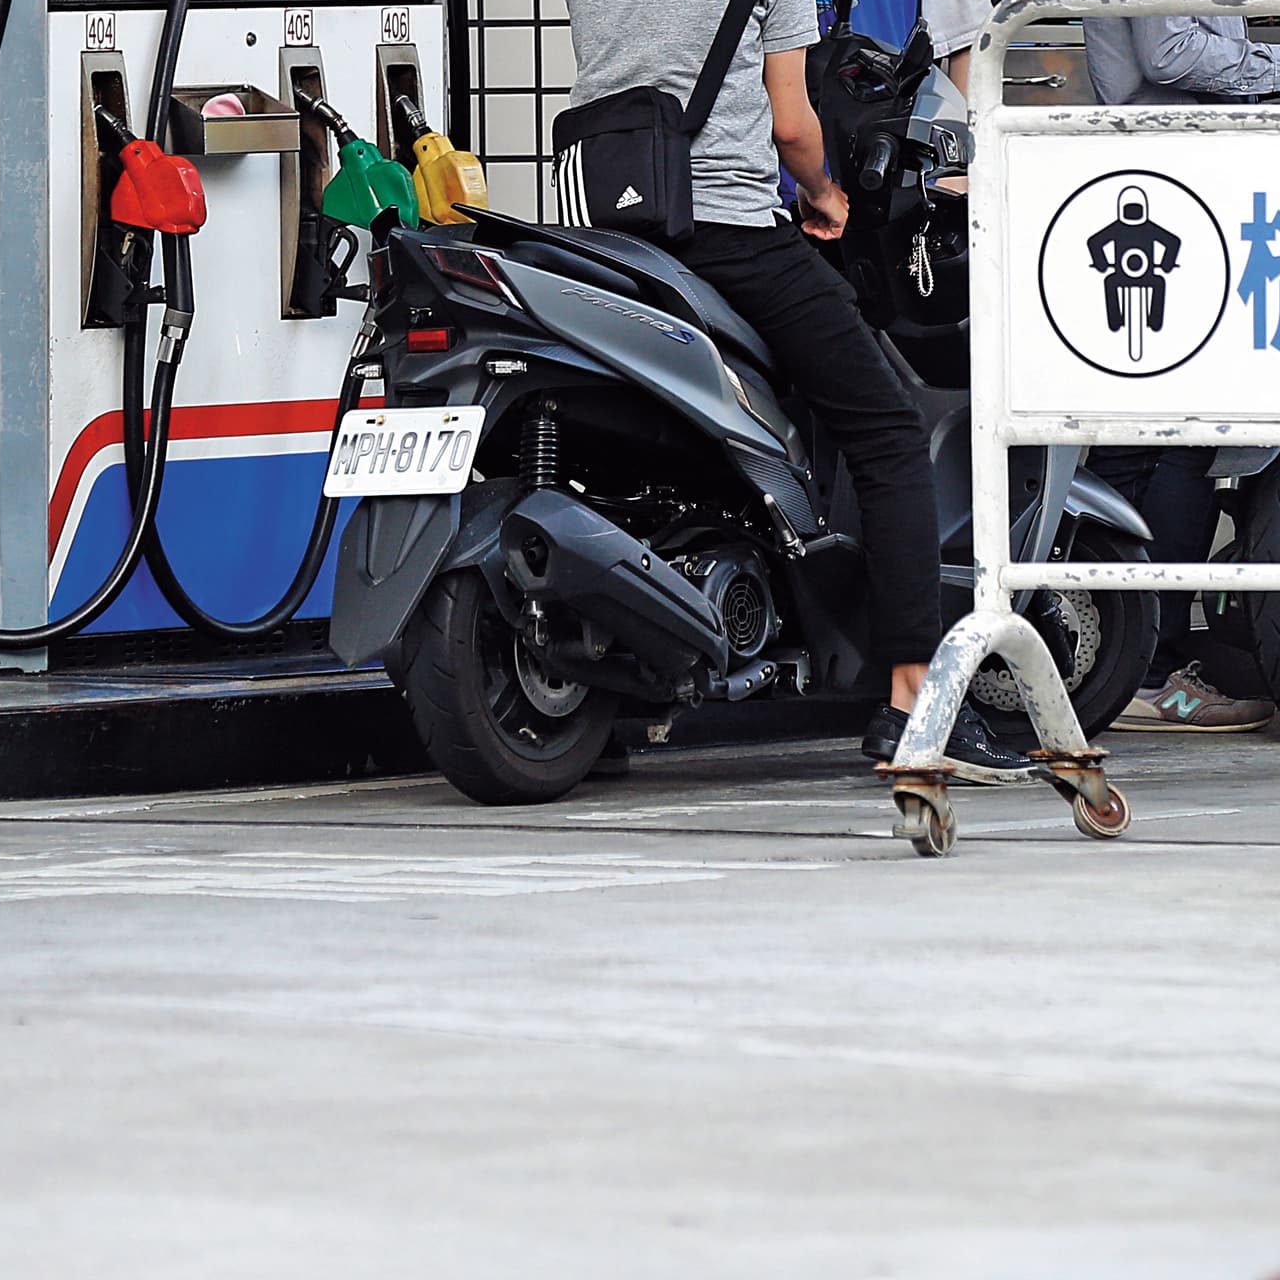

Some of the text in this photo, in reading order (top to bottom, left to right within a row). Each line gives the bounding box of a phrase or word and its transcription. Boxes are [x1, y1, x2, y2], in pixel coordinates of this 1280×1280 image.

[88, 18, 113, 45] 404
[287, 14, 311, 42] 405
[383, 12, 407, 40] 406
